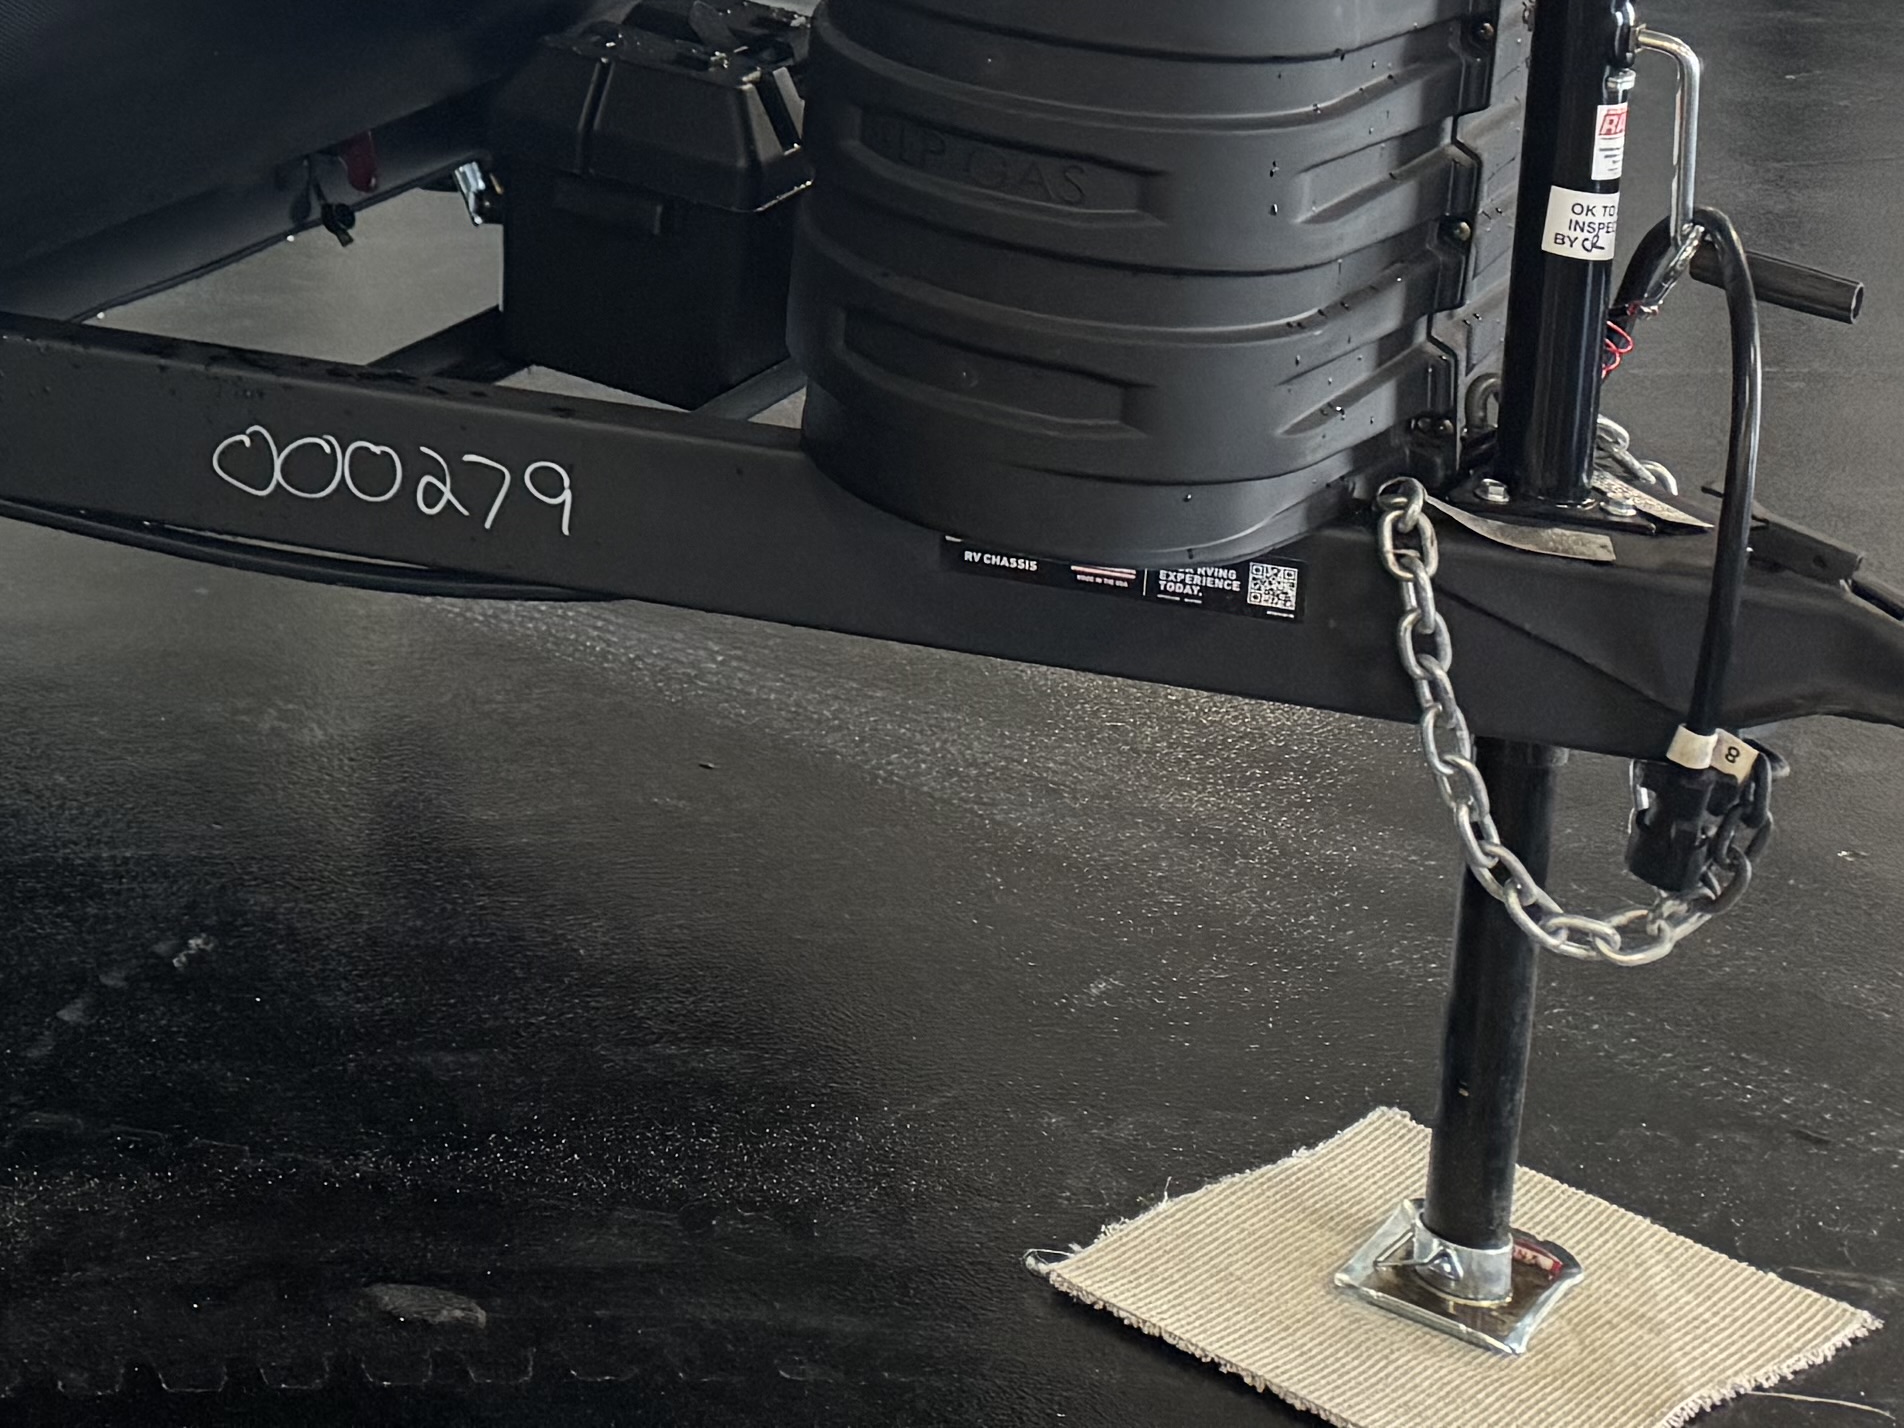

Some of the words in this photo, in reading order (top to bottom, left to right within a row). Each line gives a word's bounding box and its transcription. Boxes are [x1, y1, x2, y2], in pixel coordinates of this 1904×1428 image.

[1571, 202, 1597, 217] OK
[1553, 232, 1579, 248] BY
[212, 425, 573, 536] 000279
[964, 550, 983, 563] RV
[983, 553, 1038, 571] CHASSIS
[1158, 570, 1241, 592] EXPERIENCE
[1158, 580, 1203, 597] TODAY.
